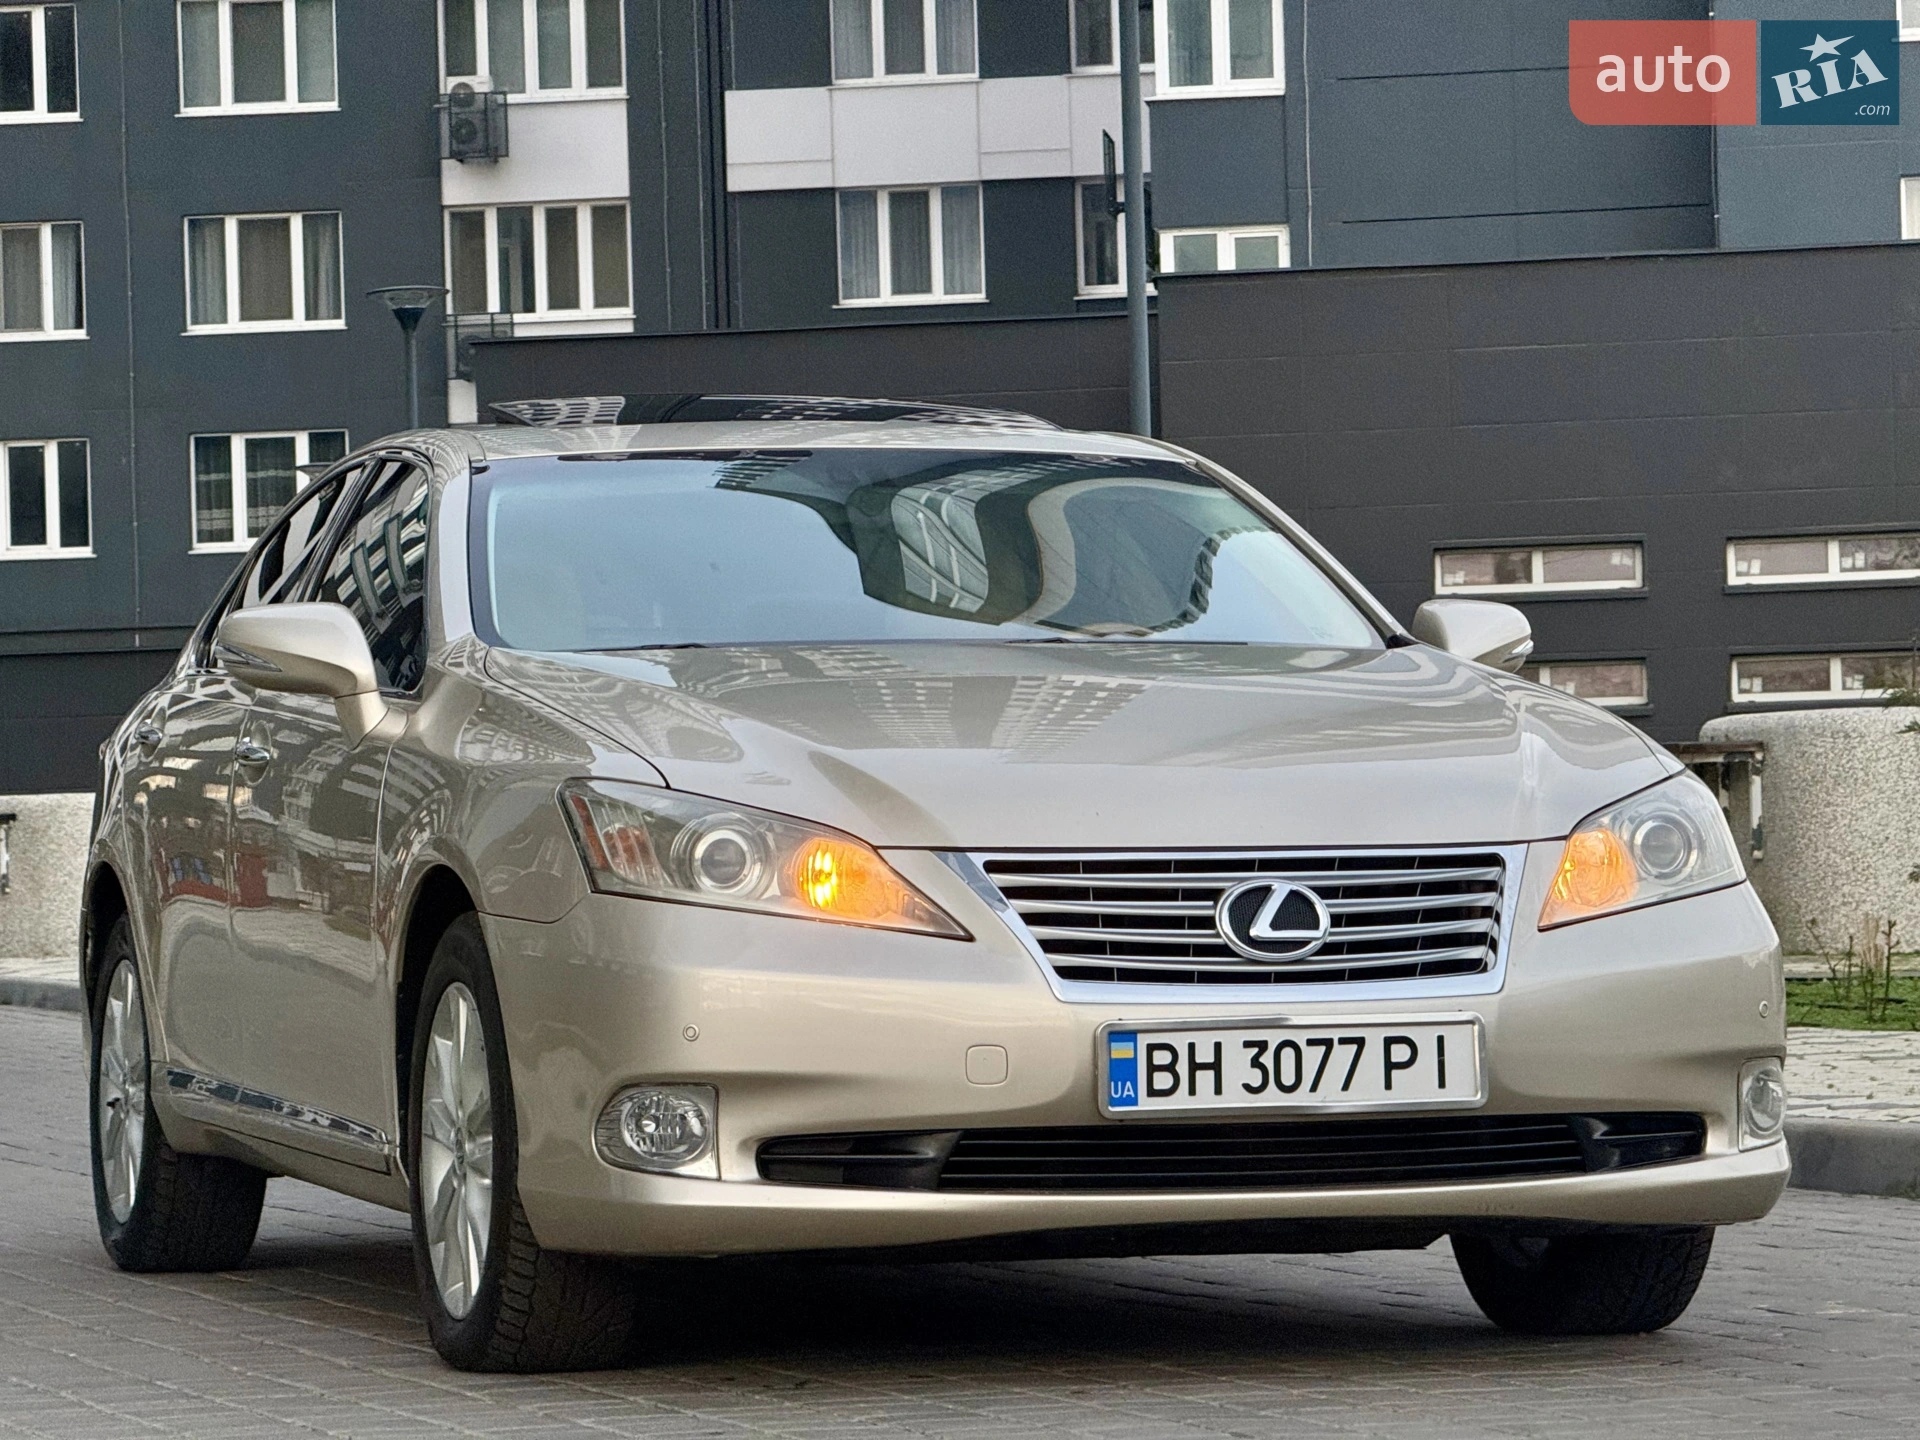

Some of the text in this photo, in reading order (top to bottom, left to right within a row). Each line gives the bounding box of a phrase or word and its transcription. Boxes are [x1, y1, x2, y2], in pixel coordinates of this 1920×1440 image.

[1146, 1041, 1222, 1098] BH
[1242, 1036, 1366, 1094] 3077
[1110, 1081, 1135, 1099] UA
